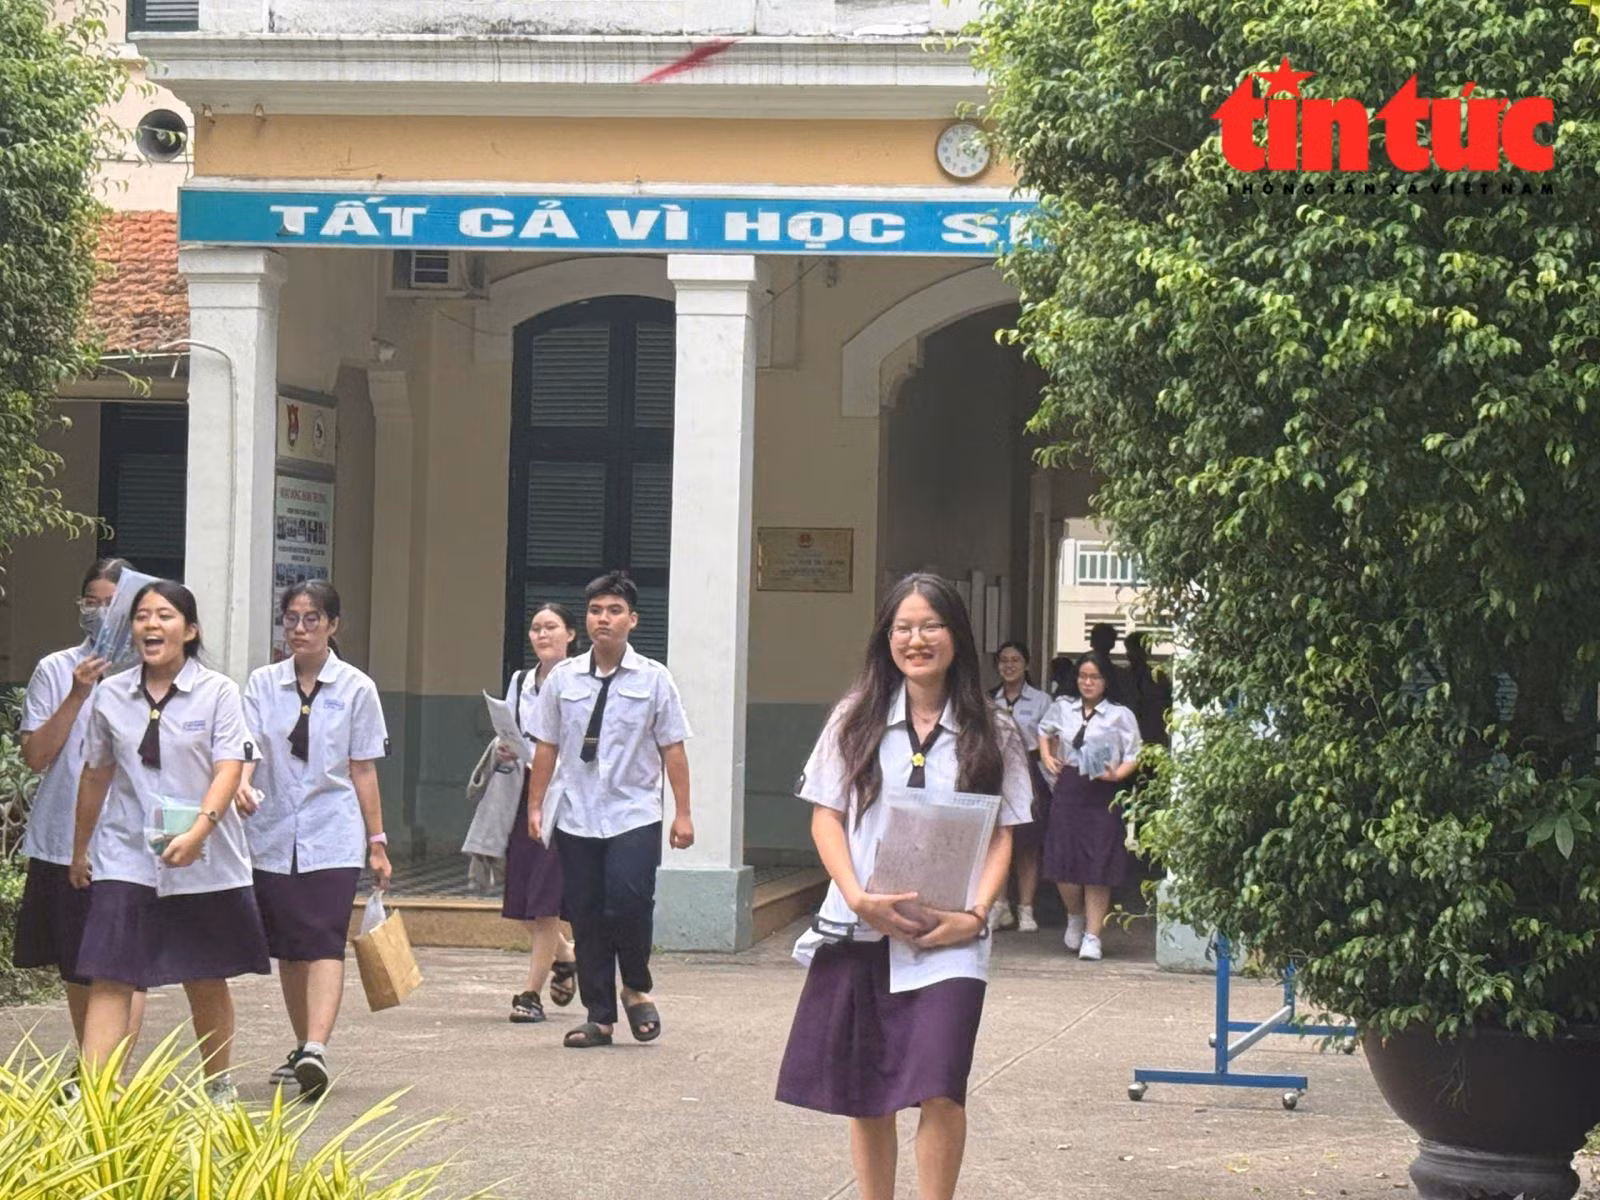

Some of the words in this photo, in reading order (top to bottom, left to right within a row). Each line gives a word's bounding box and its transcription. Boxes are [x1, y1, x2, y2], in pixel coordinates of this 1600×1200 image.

[270, 197, 428, 237] TẤT
[458, 200, 579, 239] CẢ
[605, 204, 690, 241] VÌ
[724, 211, 905, 249] HỌC
[941, 212, 1056, 246] SI
